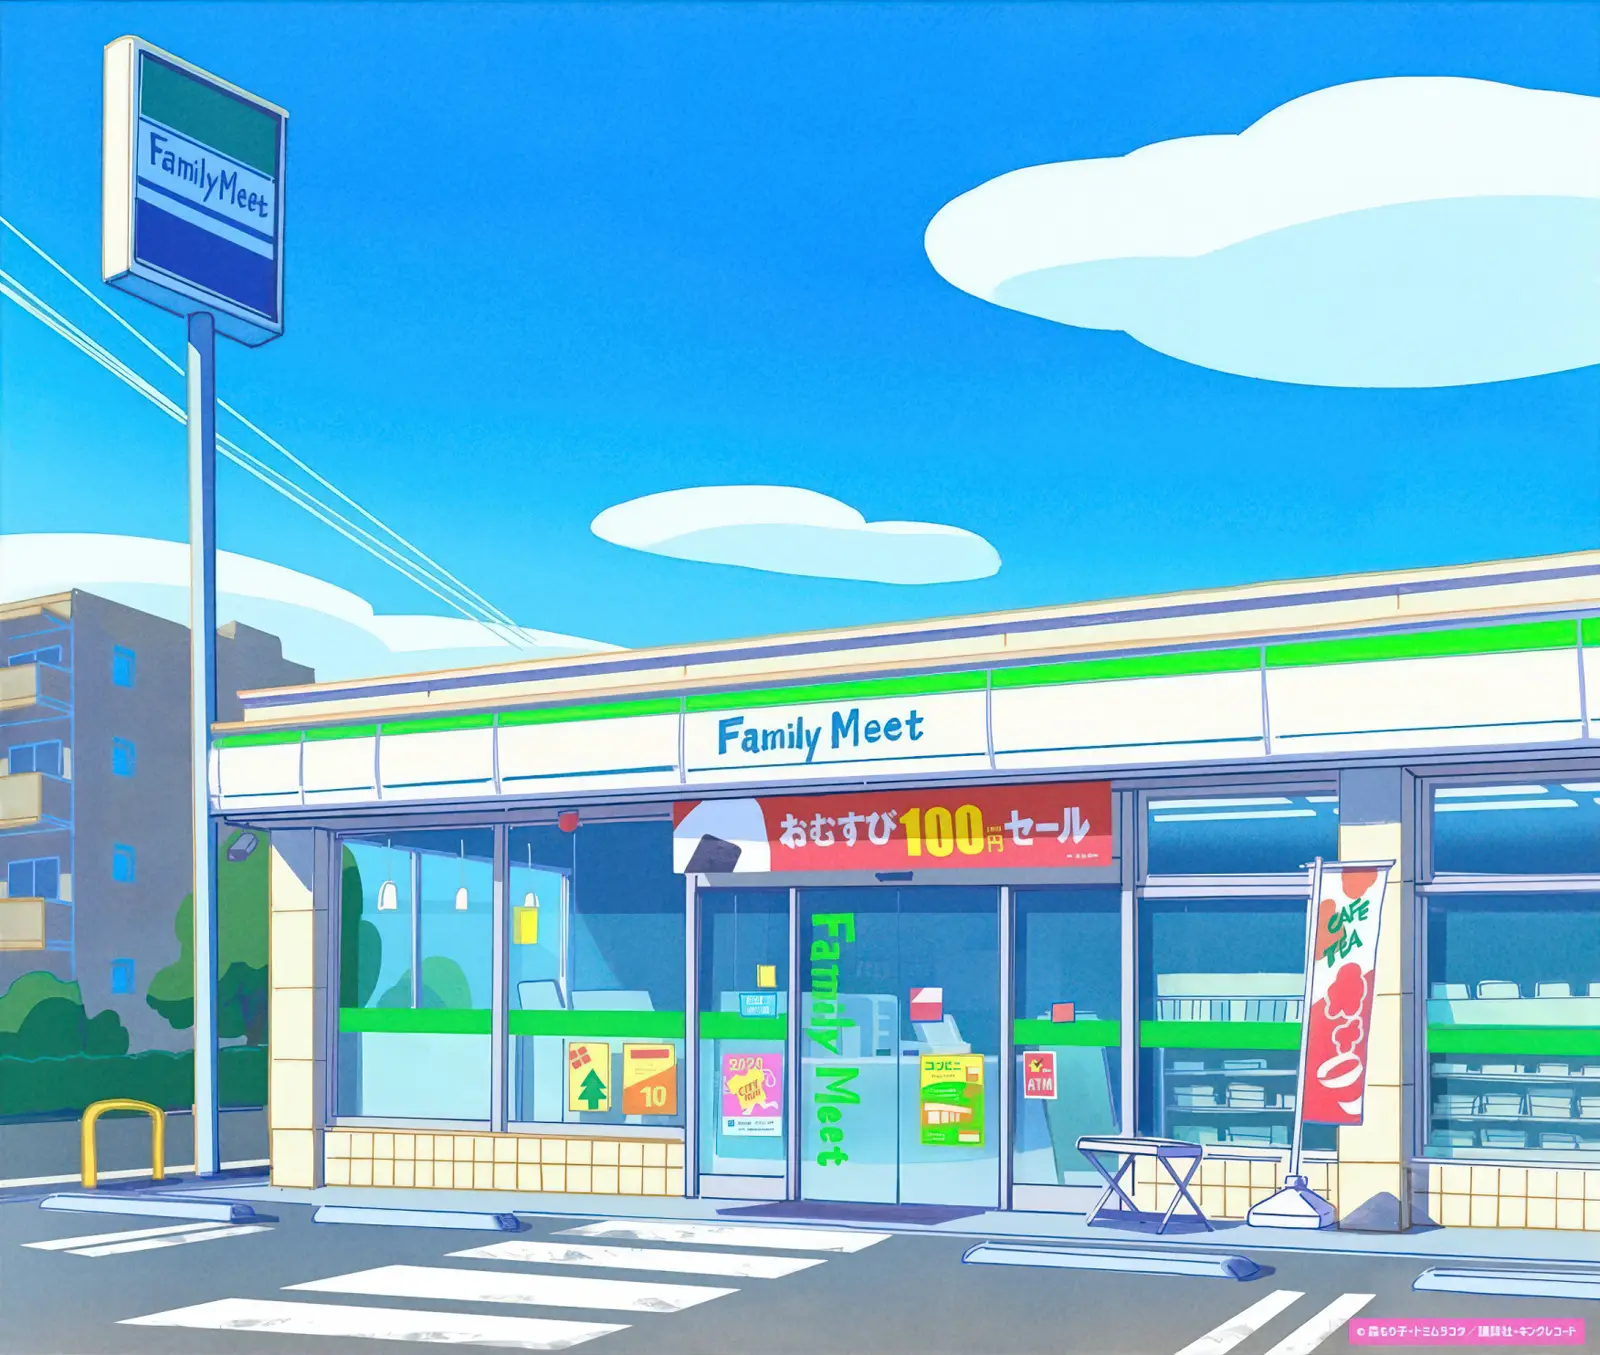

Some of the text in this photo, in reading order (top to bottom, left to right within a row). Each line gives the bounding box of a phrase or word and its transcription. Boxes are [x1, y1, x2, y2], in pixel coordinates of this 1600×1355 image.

[718, 708, 924, 764] Family Meet
[1327, 897, 1370, 934] CAFE
[1323, 923, 1363, 968] TEA
[804, 912, 860, 1167] Family Meet
[925, 1061, 961, 1071] コンビニ
[1027, 1077, 1053, 1091] ATM
[640, 1085, 667, 1108] 10
